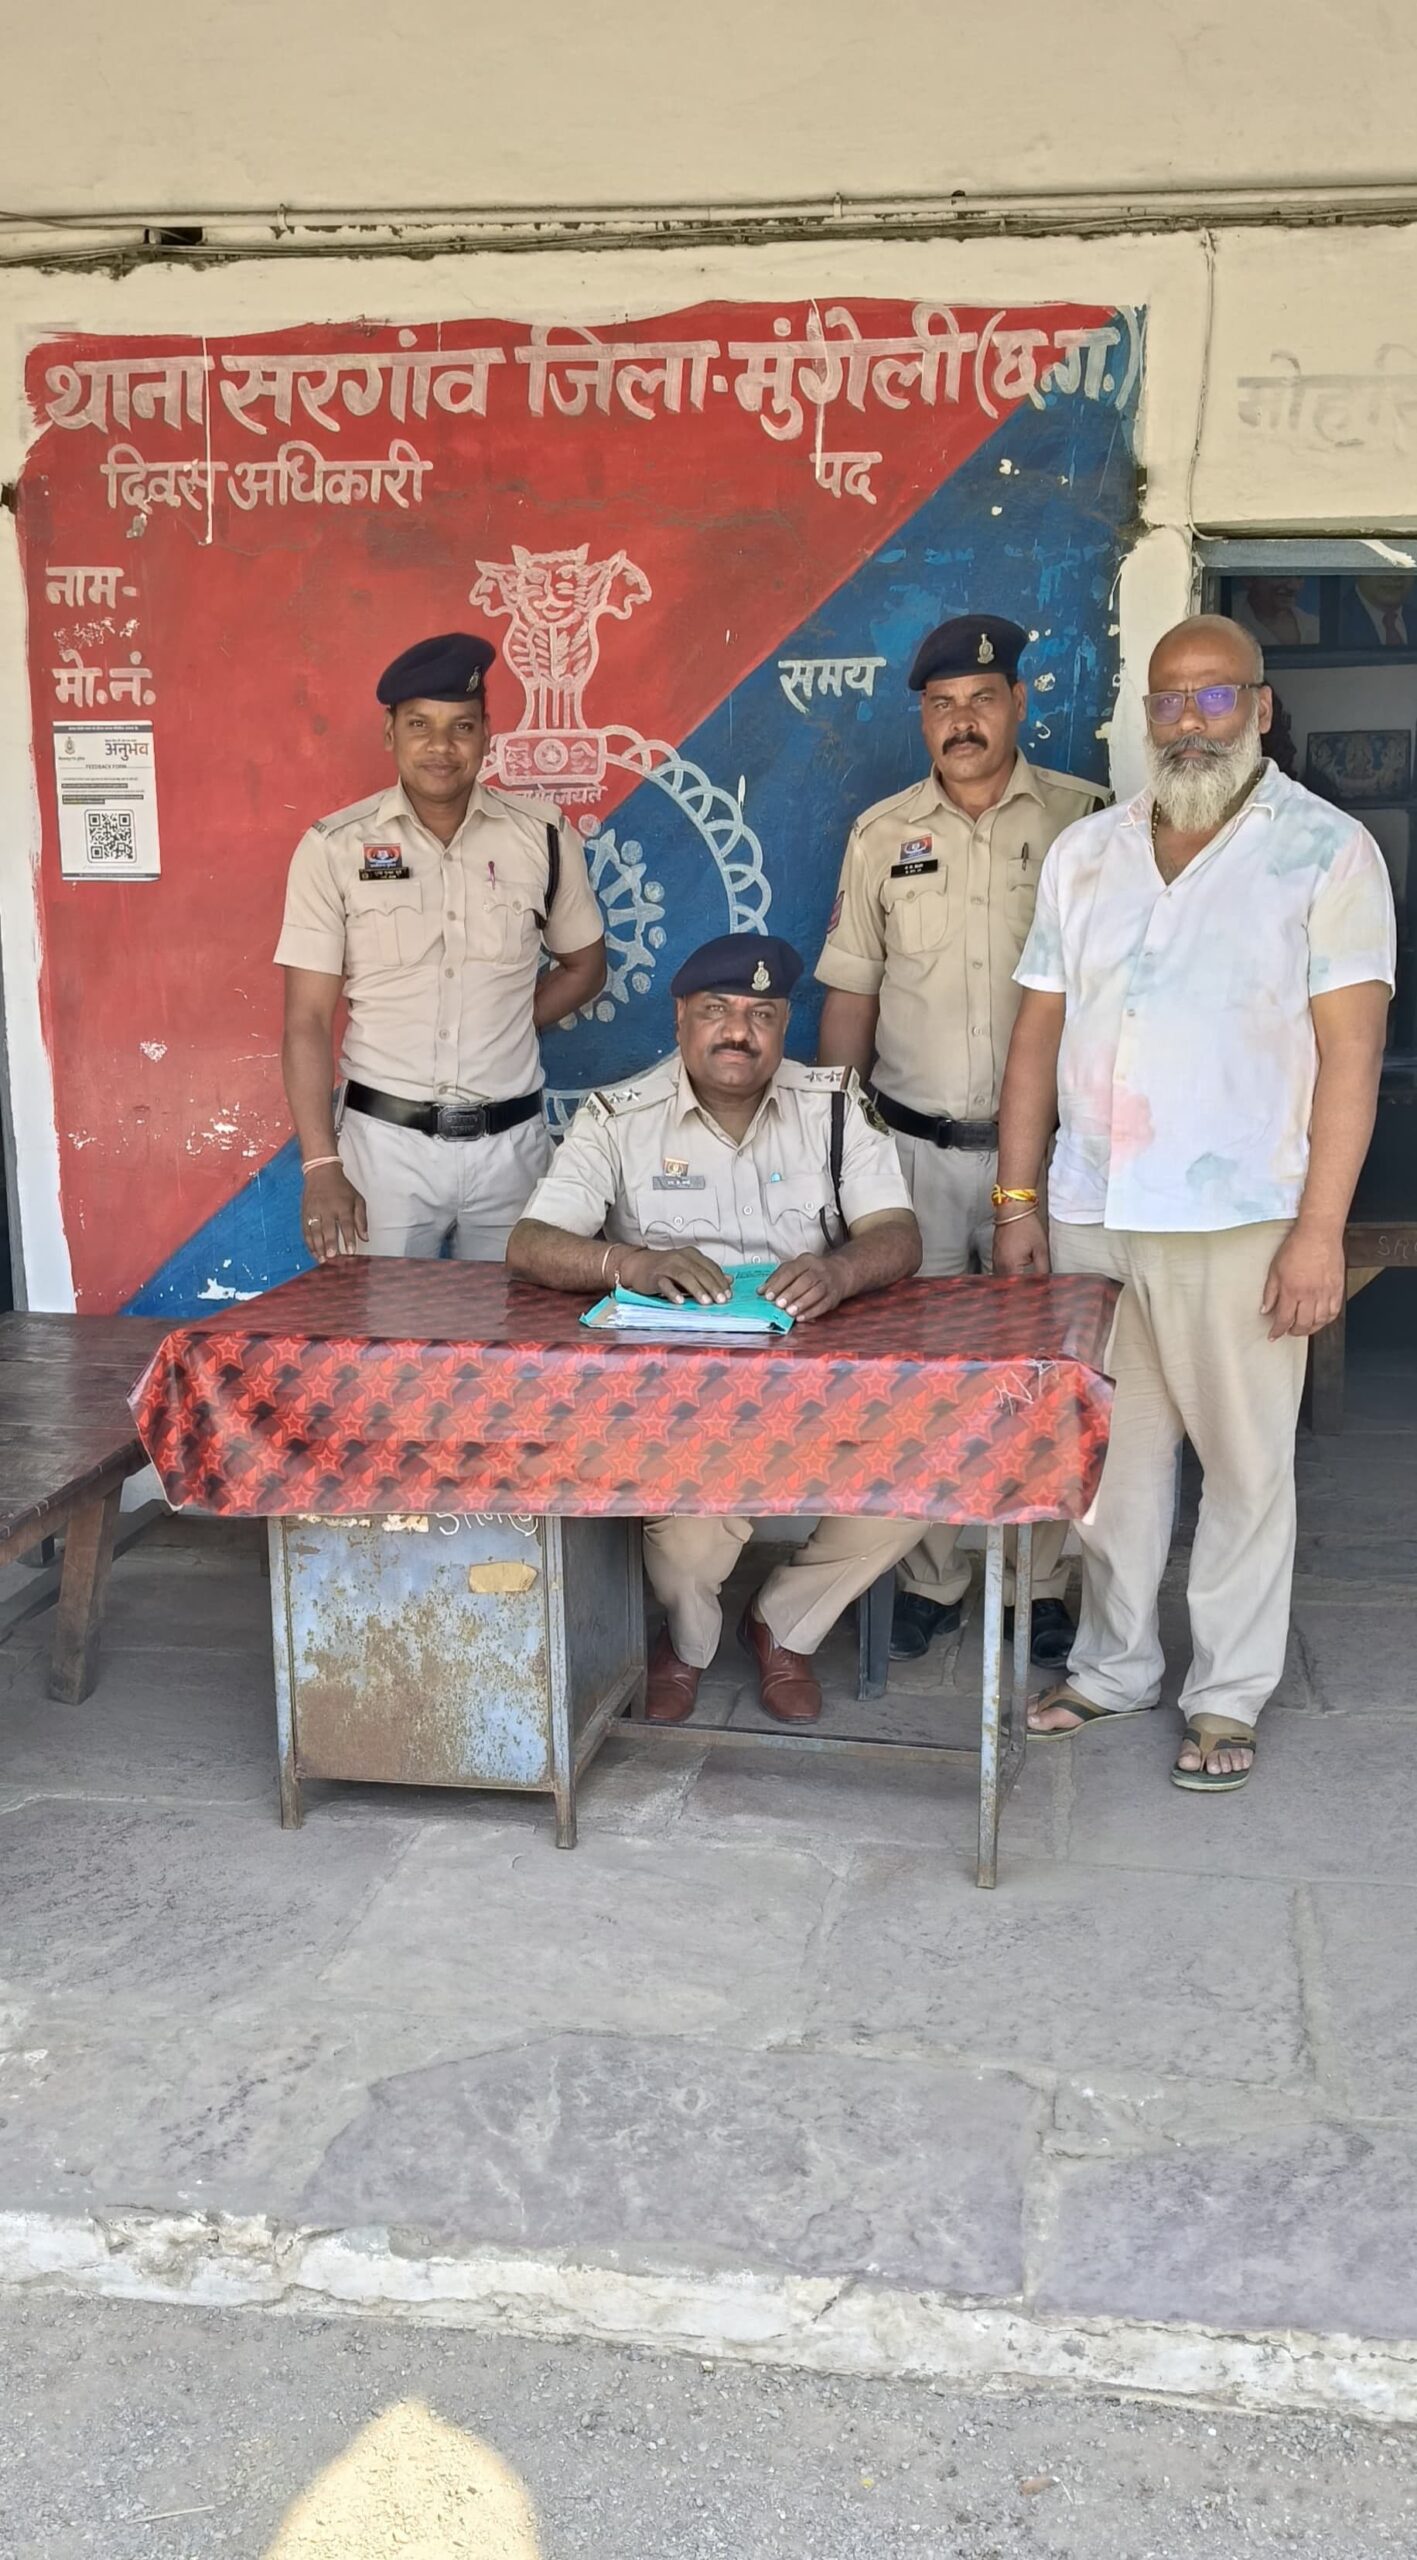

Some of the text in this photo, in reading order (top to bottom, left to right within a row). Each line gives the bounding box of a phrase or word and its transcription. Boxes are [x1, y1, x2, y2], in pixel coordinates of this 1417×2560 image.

[45, 355, 214, 433] थाना
[220, 328, 507, 435] सरगांव
[100, 439, 434, 514] दिवस अधिकारी
[809, 451, 883, 505] पद
[778, 656, 887, 715] समय
[104, 742, 149, 761] अनुभव
